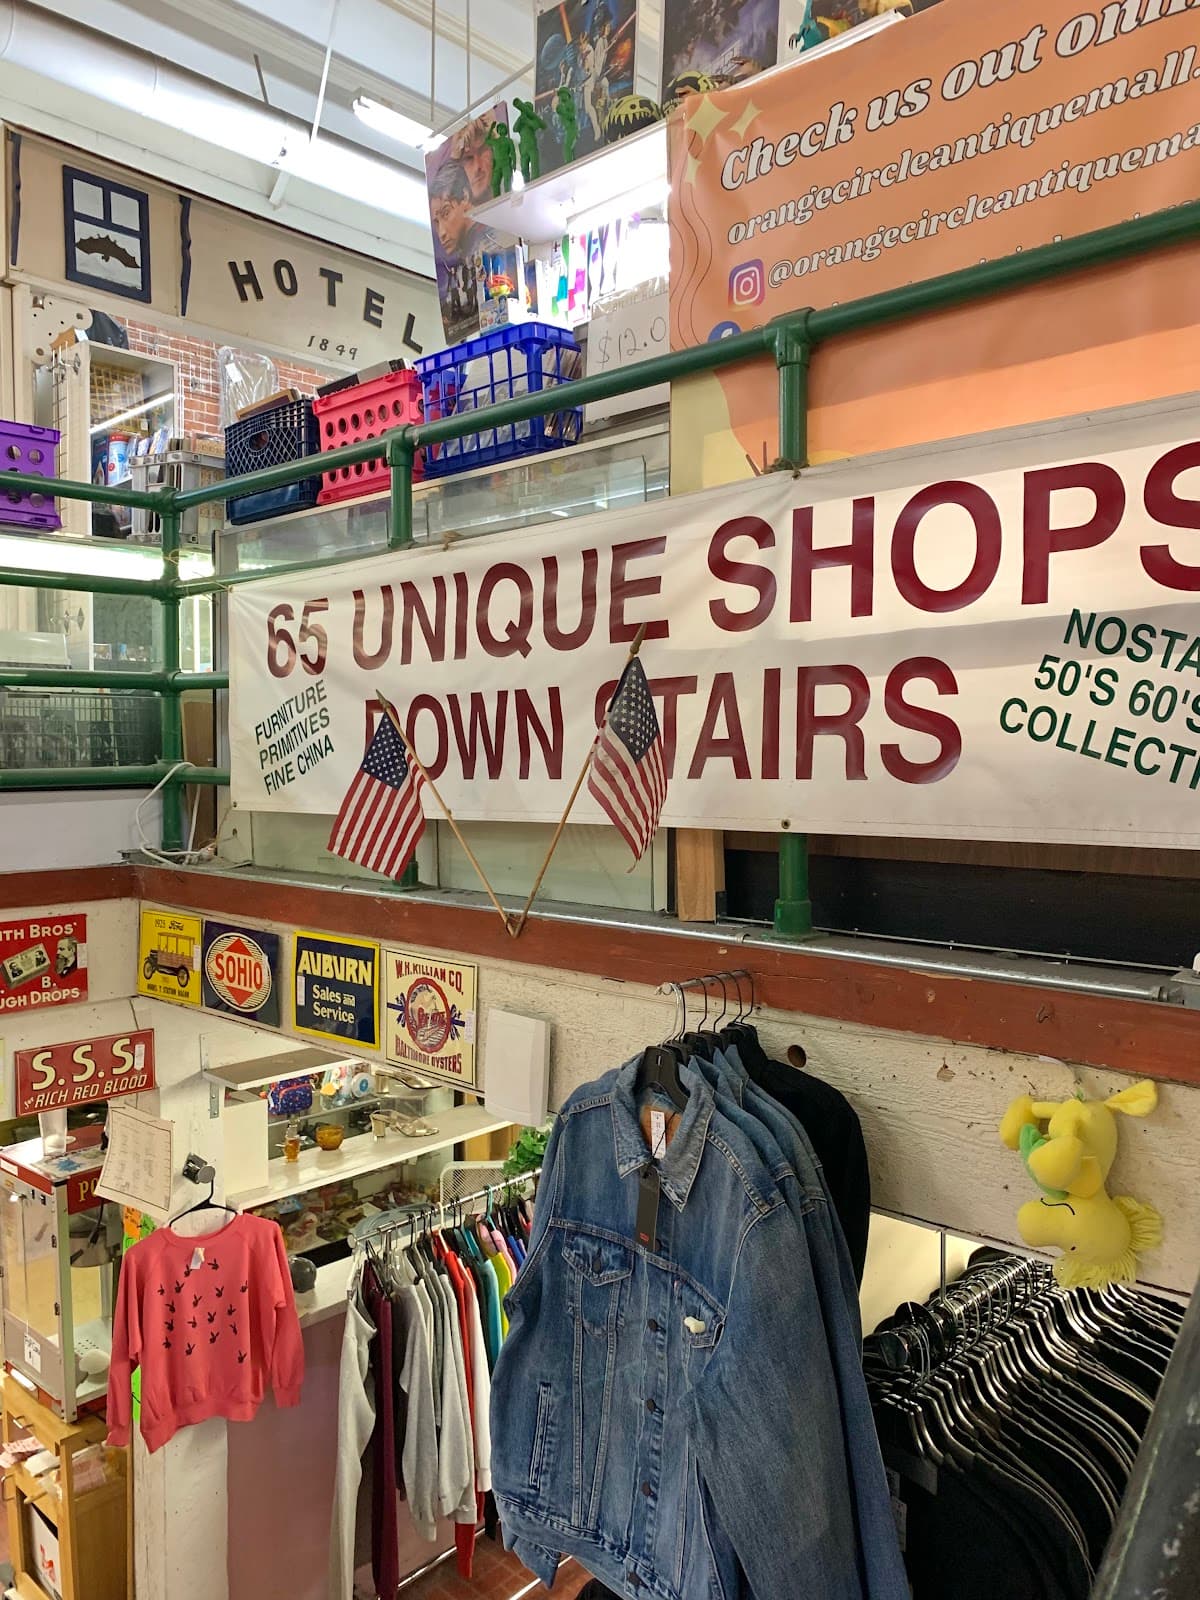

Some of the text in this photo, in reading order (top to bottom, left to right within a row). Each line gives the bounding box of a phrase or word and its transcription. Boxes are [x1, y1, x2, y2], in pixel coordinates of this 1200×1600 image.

[721, 101, 858, 191] Check
[866, 78, 932, 132] us
[941, 24, 1047, 101] out
[228, 258, 423, 354] HOTEL
[307, 335, 359, 361] 1849
[267, 441, 1200, 678] 65 UNIQUE SHOPS
[1063, 608, 1200, 678] NOSTA
[1034, 654, 1120, 706] 50'S
[255, 679, 328, 745] FURNITURE
[259, 706, 331, 770] PRIMITIVES
[263, 734, 335, 796] FINE CHINA
[215, 953, 263, 990] SOHIO
[297, 949, 372, 986] AUBURN
[30, 987, 80, 1005] DROPS
[312, 984, 341, 1004] Sales
[312, 1001, 355, 1025] Service
[431, 1052, 463, 1075] OYSTERS
[35, 1089, 68, 1108] RICH
[72, 1083, 100, 1101] RED
[103, 1074, 148, 1094] BLOOD
